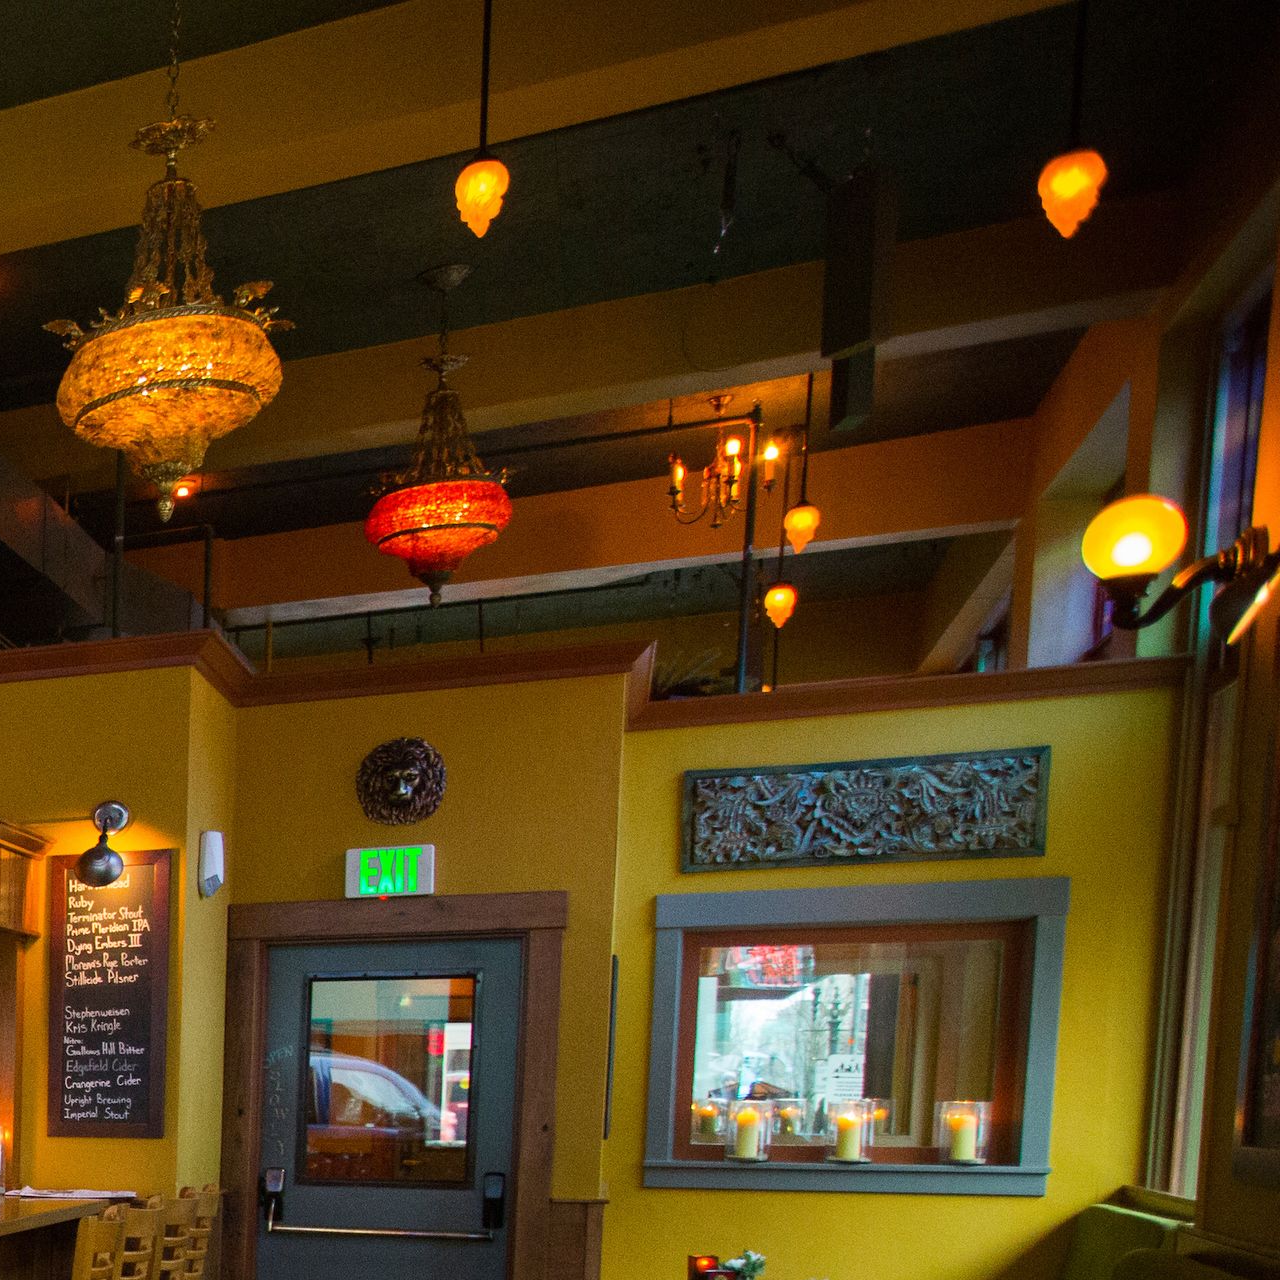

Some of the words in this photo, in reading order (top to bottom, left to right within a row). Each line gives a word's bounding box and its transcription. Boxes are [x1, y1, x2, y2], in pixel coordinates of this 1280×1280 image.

[360, 847, 422, 895] EXIT
[68, 895, 94, 911] Ruby
[68, 908, 117, 923] Terminator
[118, 905, 143, 920] Stout
[67, 924, 91, 937] Prime
[91, 922, 129, 934] Meridian
[131, 919, 150, 932] IPA
[67, 938, 93, 956] Dying
[95, 936, 128, 950] Embers
[128, 933, 142, 948] III
[102, 952, 118, 969] Rye
[121, 952, 148, 967] Porter
[107, 969, 139, 984] Pilsner
[65, 1020, 88, 1034] Kris
[90, 1018, 122, 1036] Kringle
[65, 1044, 101, 1057] Gallows
[101, 1041, 116, 1055] Hill
[118, 1041, 145, 1055] Bitter
[66, 1059, 108, 1077] Edgefield
[111, 1058, 138, 1072] Cider
[116, 1073, 142, 1086] Cider
[64, 1094, 93, 1108] Upright
[96, 1093, 132, 1109] Brewing
[63, 1106, 98, 1121] Imperial
[104, 1107, 130, 1120] Stout
